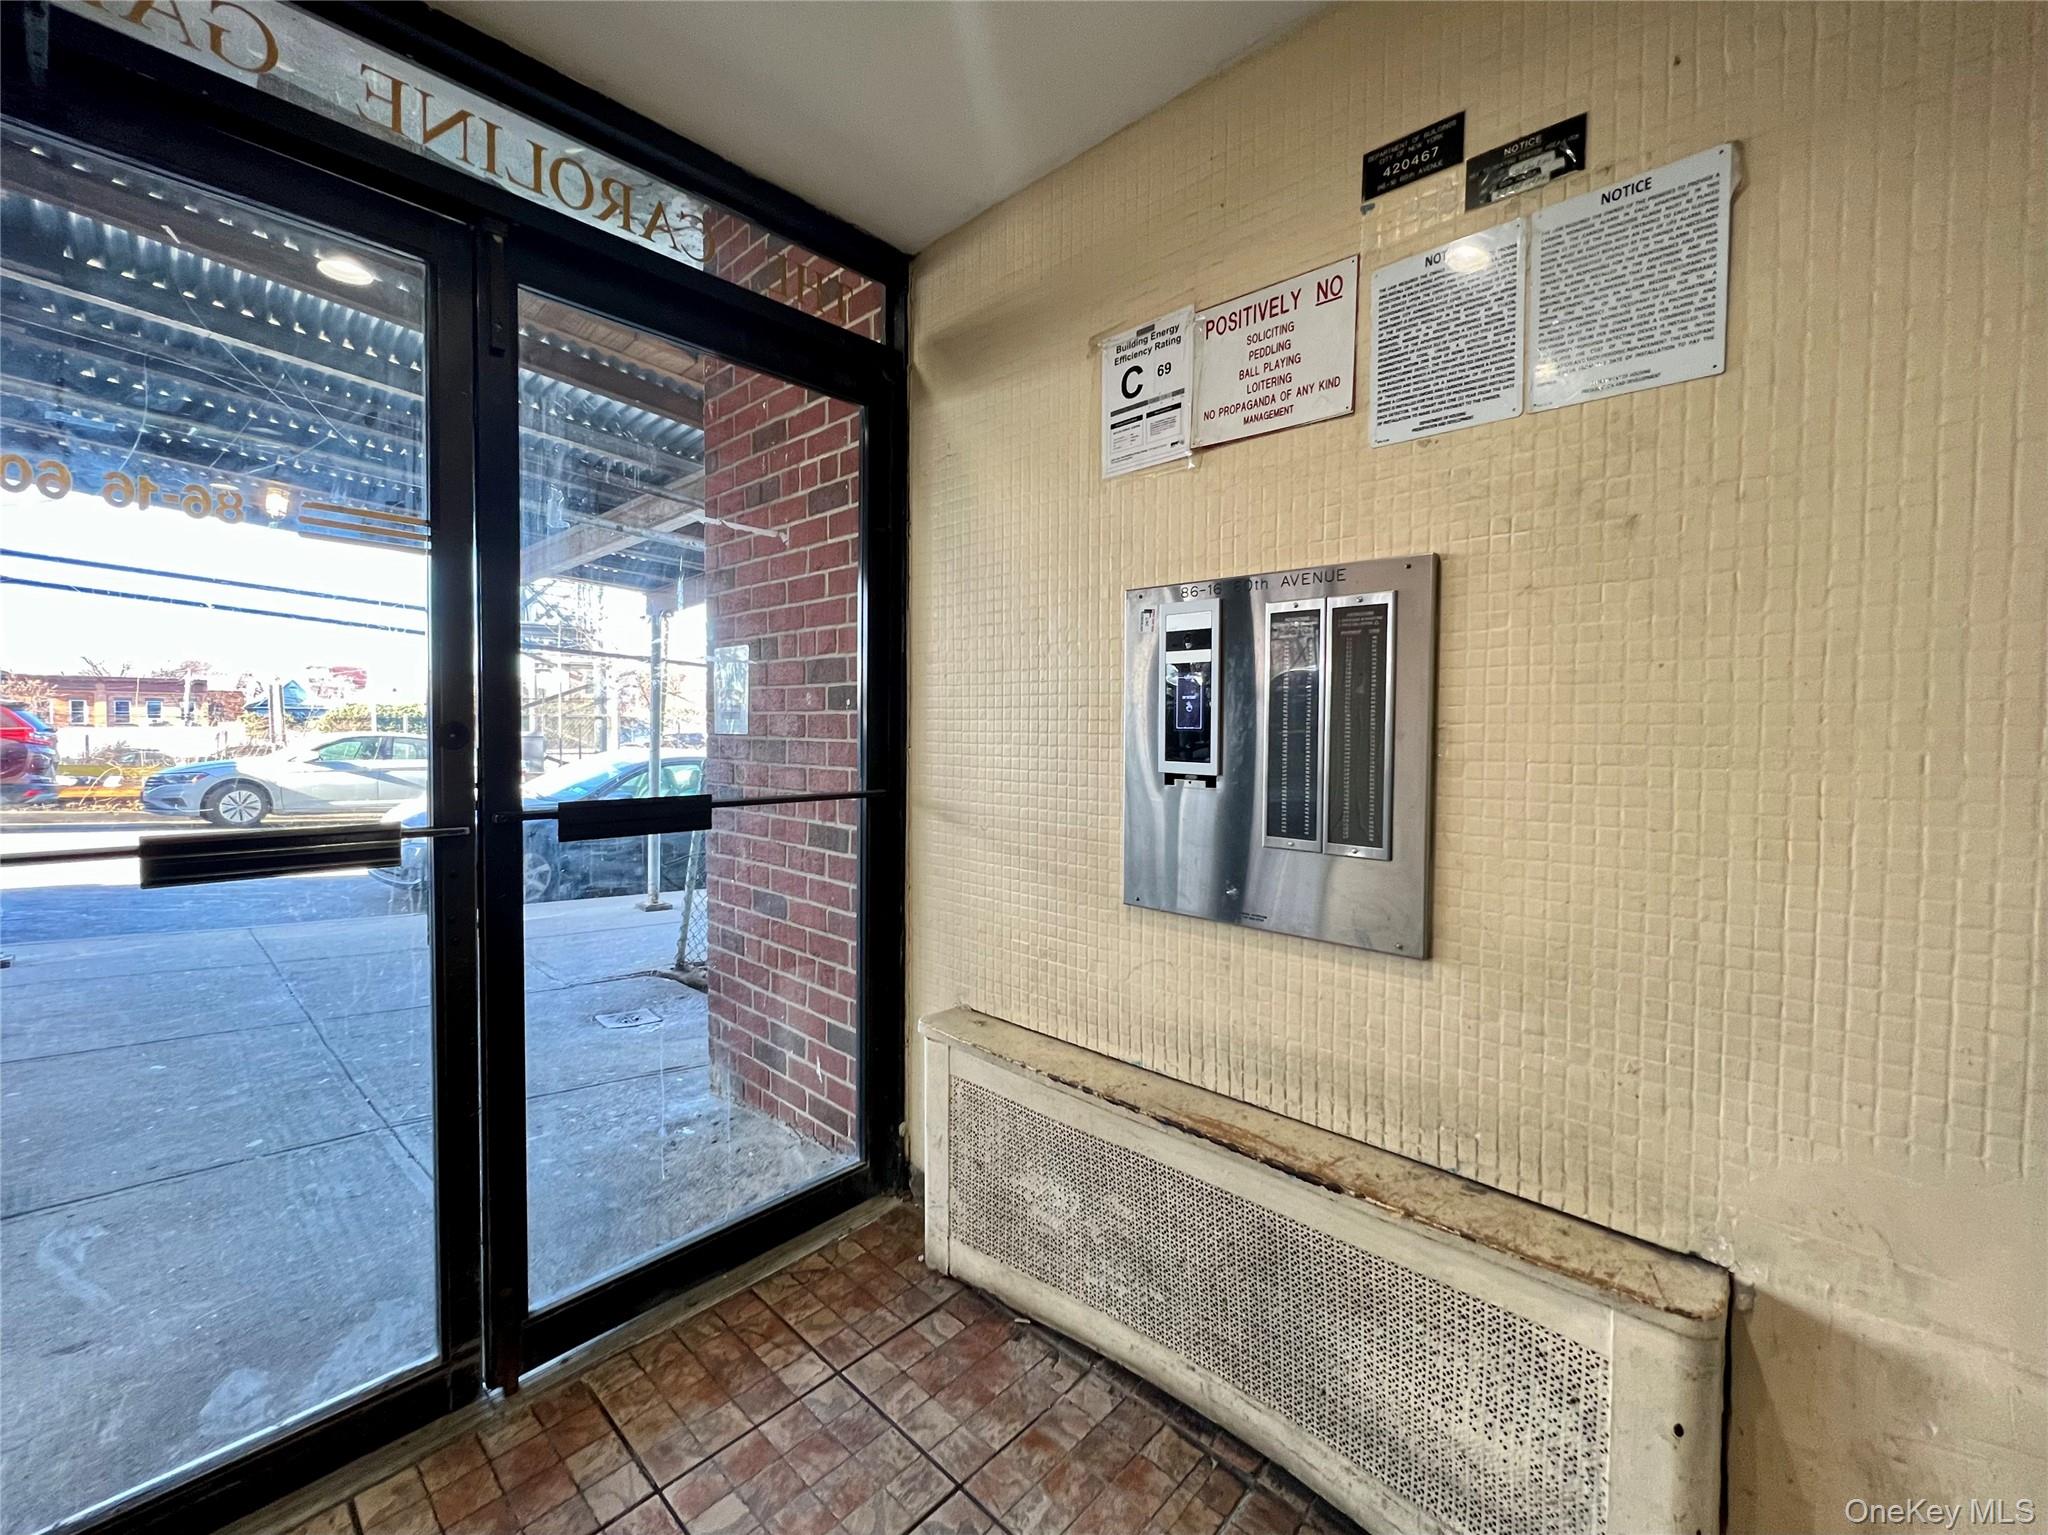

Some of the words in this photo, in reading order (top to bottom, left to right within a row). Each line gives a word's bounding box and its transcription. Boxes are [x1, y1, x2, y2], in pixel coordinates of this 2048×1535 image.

[1503, 134, 1542, 157] NOTICE
[1382, 145, 1440, 177] 420467
[1600, 176, 1652, 205] NOTICE
[1205, 288, 1302, 340] POSITIVELY
[1316, 275, 1344, 302] NO
[1116, 336, 1148, 354] Building
[1150, 323, 1180, 340] Energy
[1246, 321, 1295, 346] SOLICITING
[1114, 346, 1152, 366] Efficiency
[1154, 335, 1182, 351] Rating
[1248, 340, 1292, 361] PEDDLING
[1157, 361, 1172, 377] 69
[1239, 365, 1260, 380] BALL
[1263, 353, 1302, 373] PLAYING
[1120, 365, 1144, 400] C
[1246, 372, 1293, 394] LOITERING
[1203, 410, 1216, 421] NO
[1218, 394, 1277, 418] PROPAGANDA
[1280, 389, 1293, 402] OF
[1296, 382, 1316, 397] ANY
[1318, 376, 1341, 392] KIND
[1243, 405, 1295, 425] MANAGEMENT
[1180, 582, 1223, 599] 86-16
[1280, 567, 1347, 589] AVENUE
